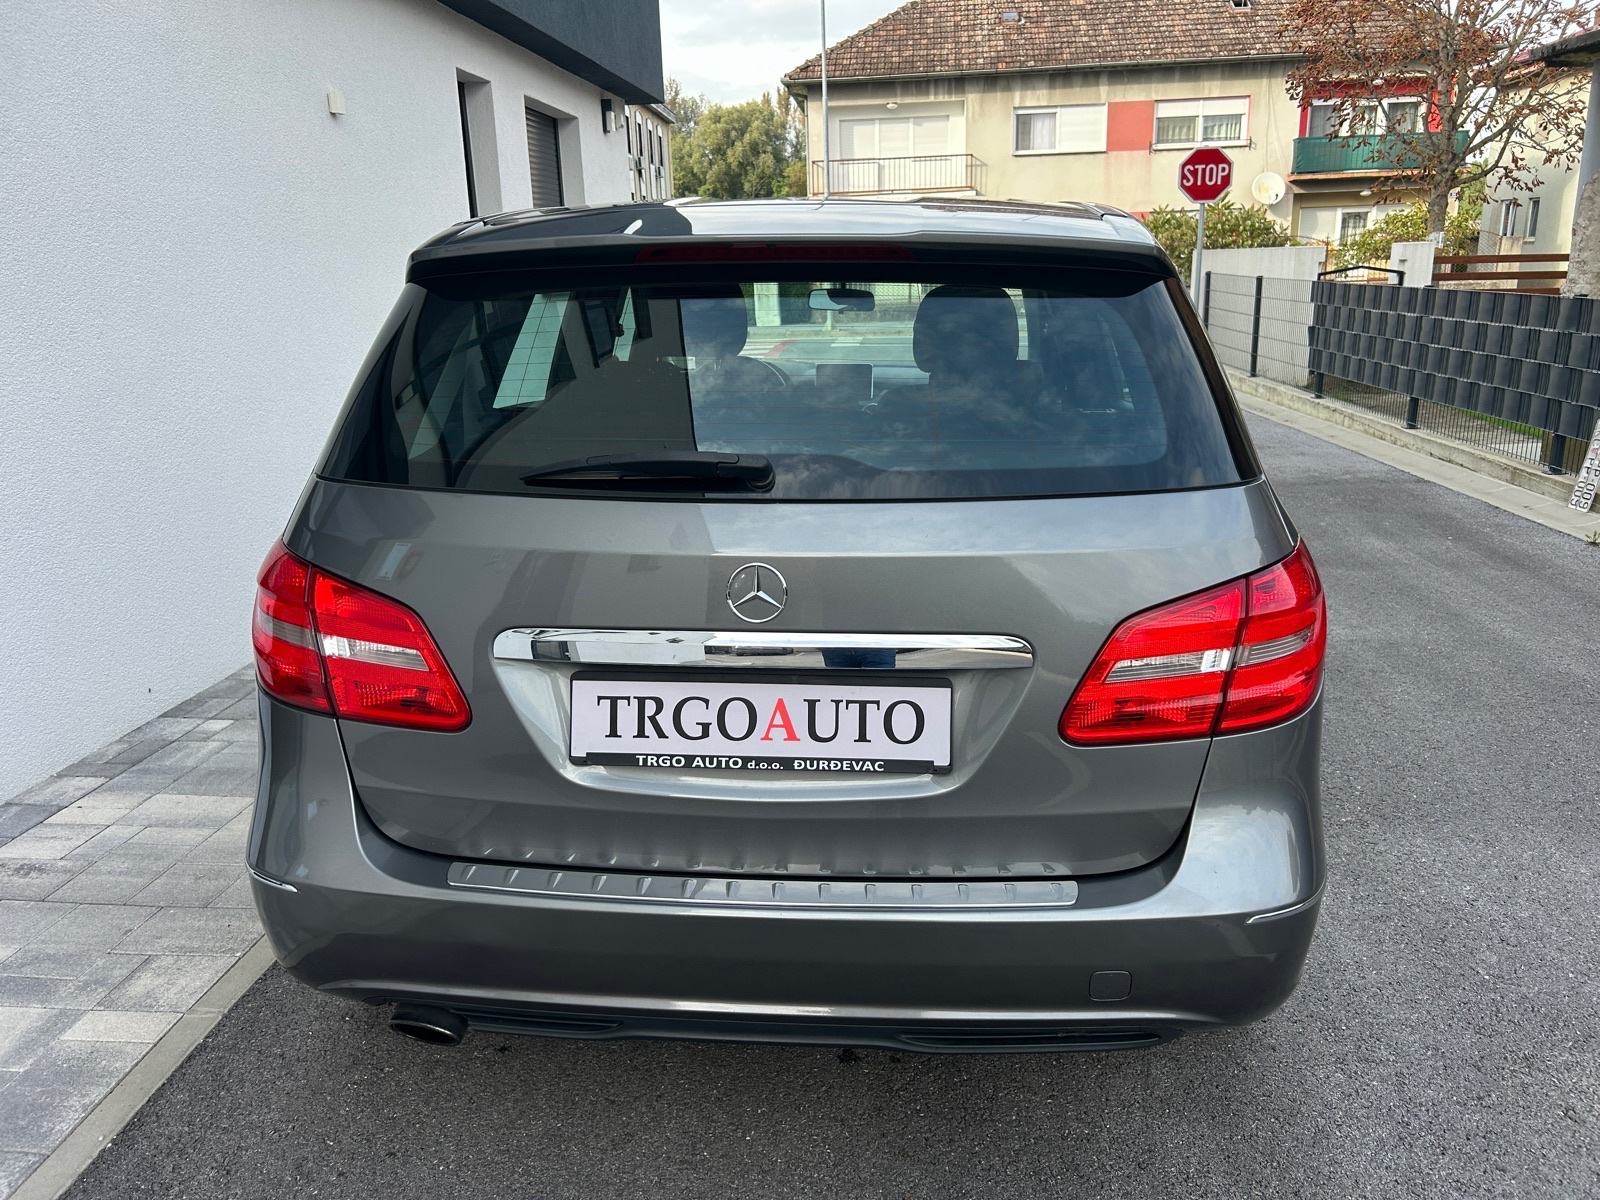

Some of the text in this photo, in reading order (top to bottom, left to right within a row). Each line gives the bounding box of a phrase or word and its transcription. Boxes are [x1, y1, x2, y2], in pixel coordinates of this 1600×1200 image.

[1182, 163, 1230, 187] STOP
[596, 695, 926, 745] TRGOAUTO
[635, 754, 885, 772] TRGO AUTO d.o.o. ĐURĐEVAC
